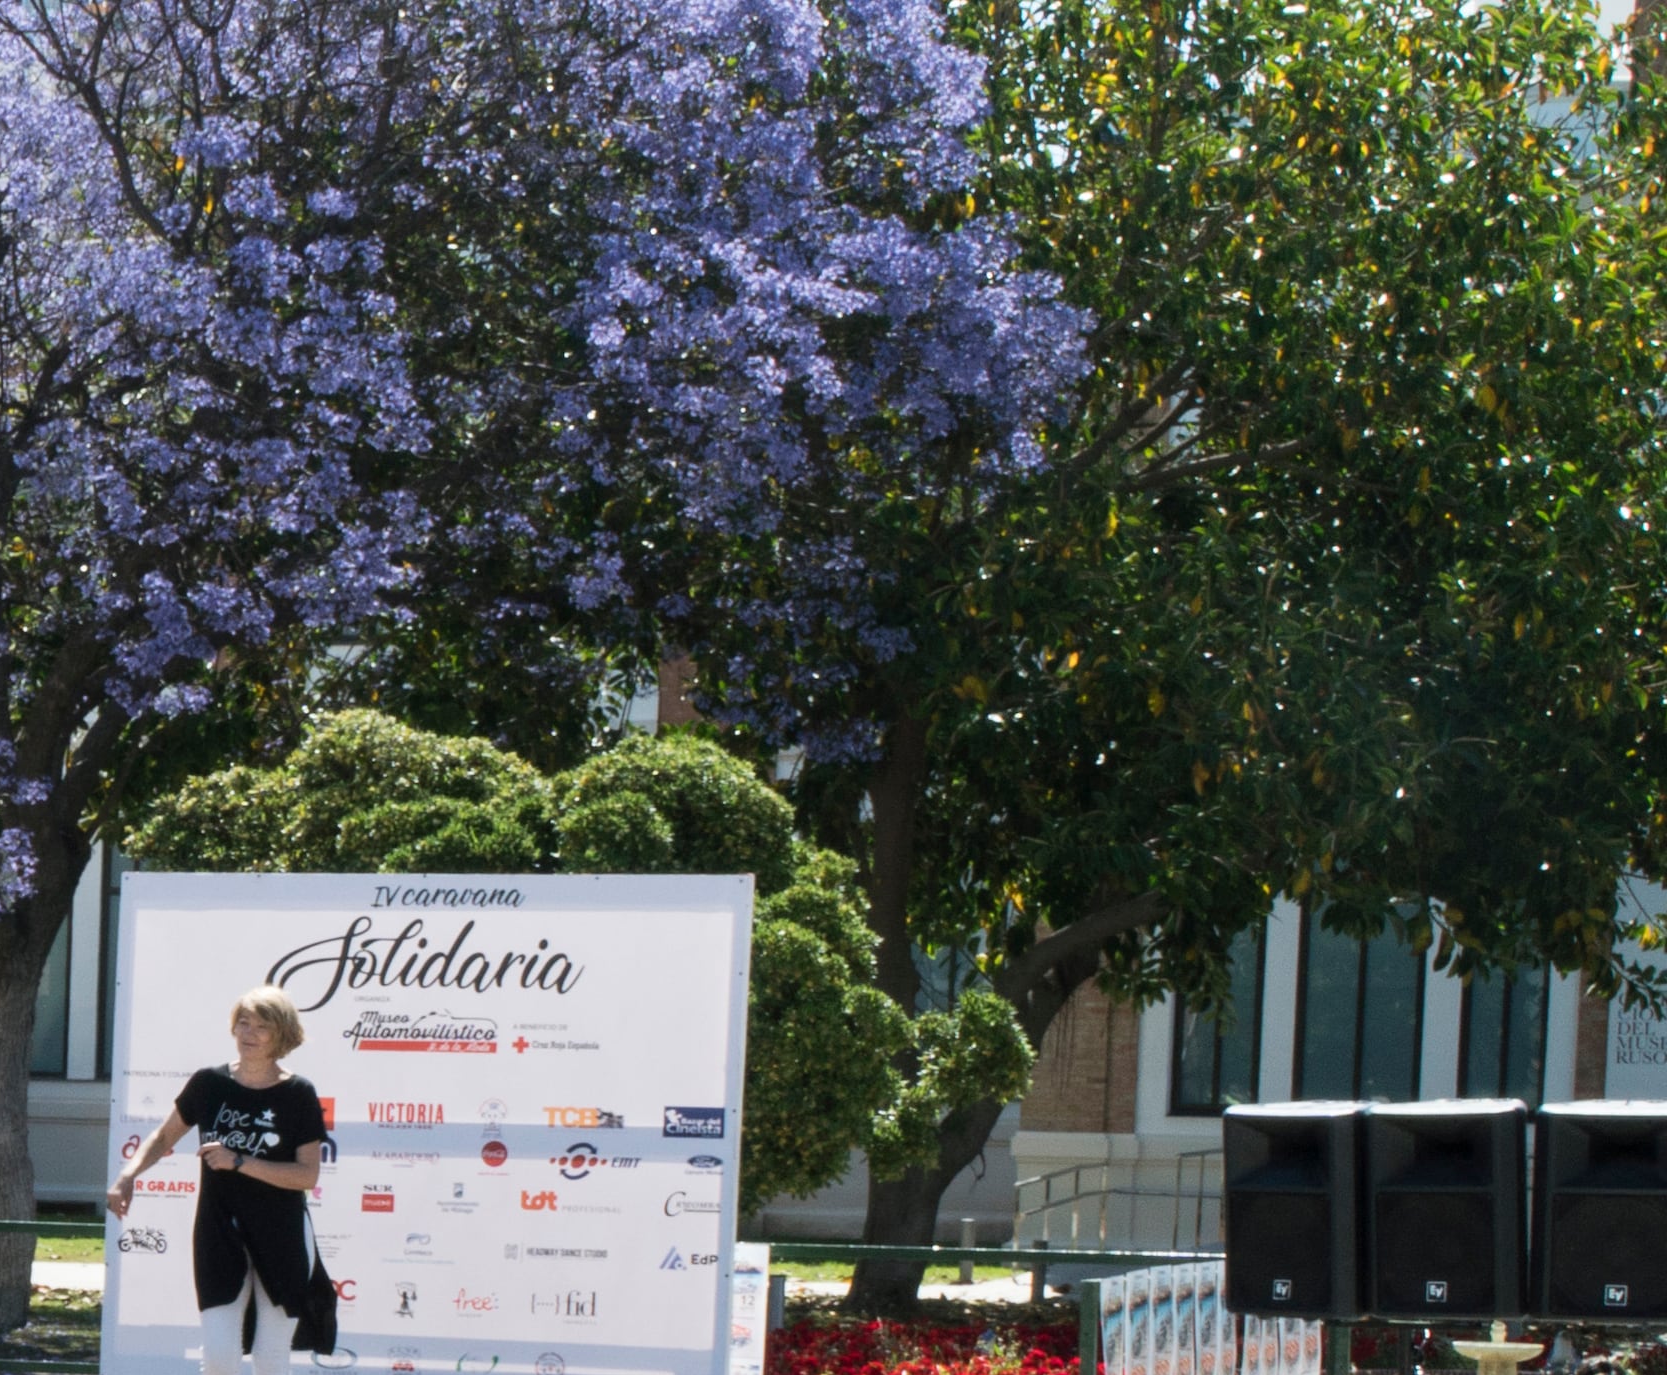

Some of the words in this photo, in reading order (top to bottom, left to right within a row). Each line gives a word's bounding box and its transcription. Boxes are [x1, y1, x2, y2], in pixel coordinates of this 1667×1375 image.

[371, 886, 400, 907] IV
[401, 886, 526, 907] caravana
[265, 916, 585, 1013] Solidaria
[360, 1011, 409, 1024] Museo
[343, 1022, 497, 1050] Automovilístico
[1618, 1022, 1656, 1036] DEL
[368, 1102, 444, 1124] VICTORIA
[543, 1106, 598, 1128] TCB
[611, 1157, 641, 1168] EMT
[147, 1181, 195, 1192] GRAFIS
[364, 1184, 392, 1192] SUR
[521, 1190, 557, 1211] tdt
[691, 1254, 718, 1266] EdP
[453, 1288, 492, 1310] free
[567, 1291, 596, 1316] fid
[741, 1295, 755, 1306] 12
